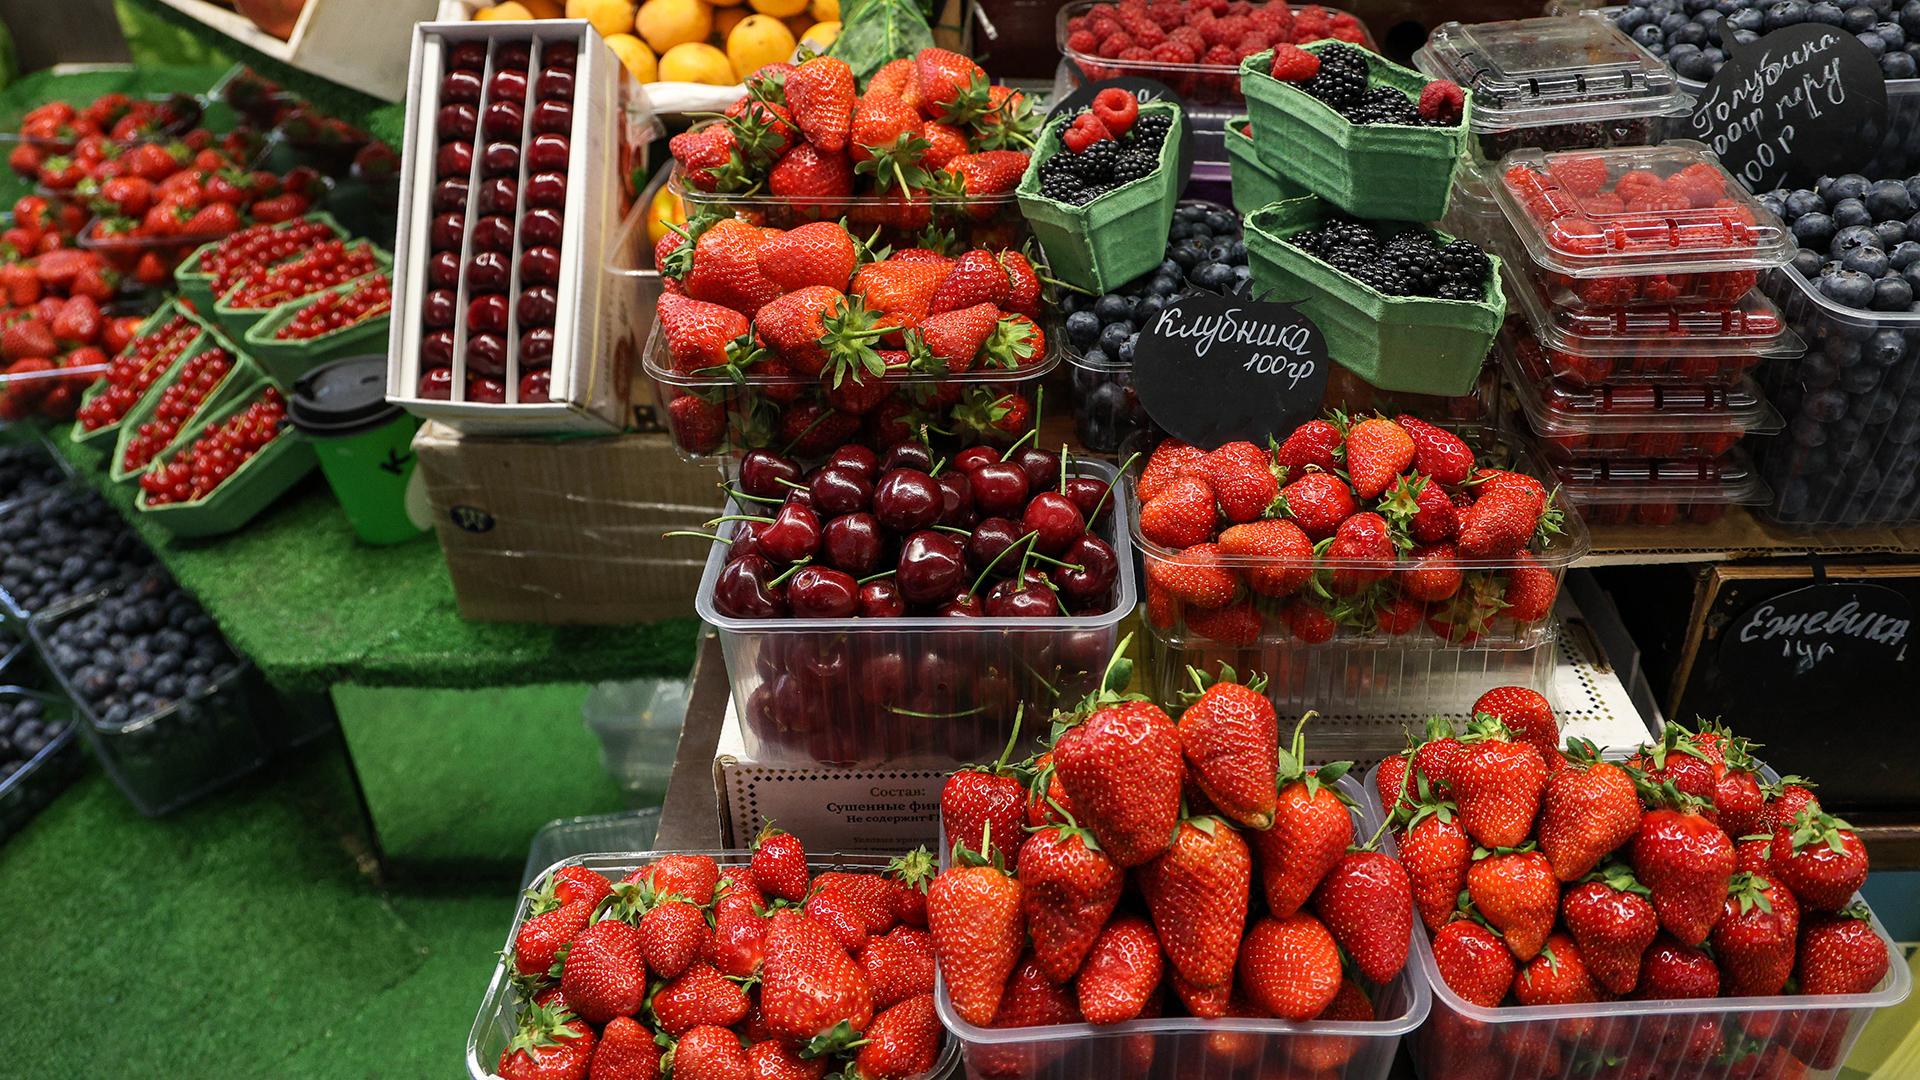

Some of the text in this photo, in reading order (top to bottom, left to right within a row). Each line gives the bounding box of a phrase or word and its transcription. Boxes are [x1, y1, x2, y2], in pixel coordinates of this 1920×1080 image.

[1154, 308, 1312, 357] Клубника
[1243, 353, 1315, 390] 100гр
[1741, 602, 1910, 646] Ежевика
[870, 786, 926, 798] Состав:
[826, 801, 940, 814] Сушенные фин
[846, 815, 862, 823] Не
[865, 815, 924, 824] содержит
